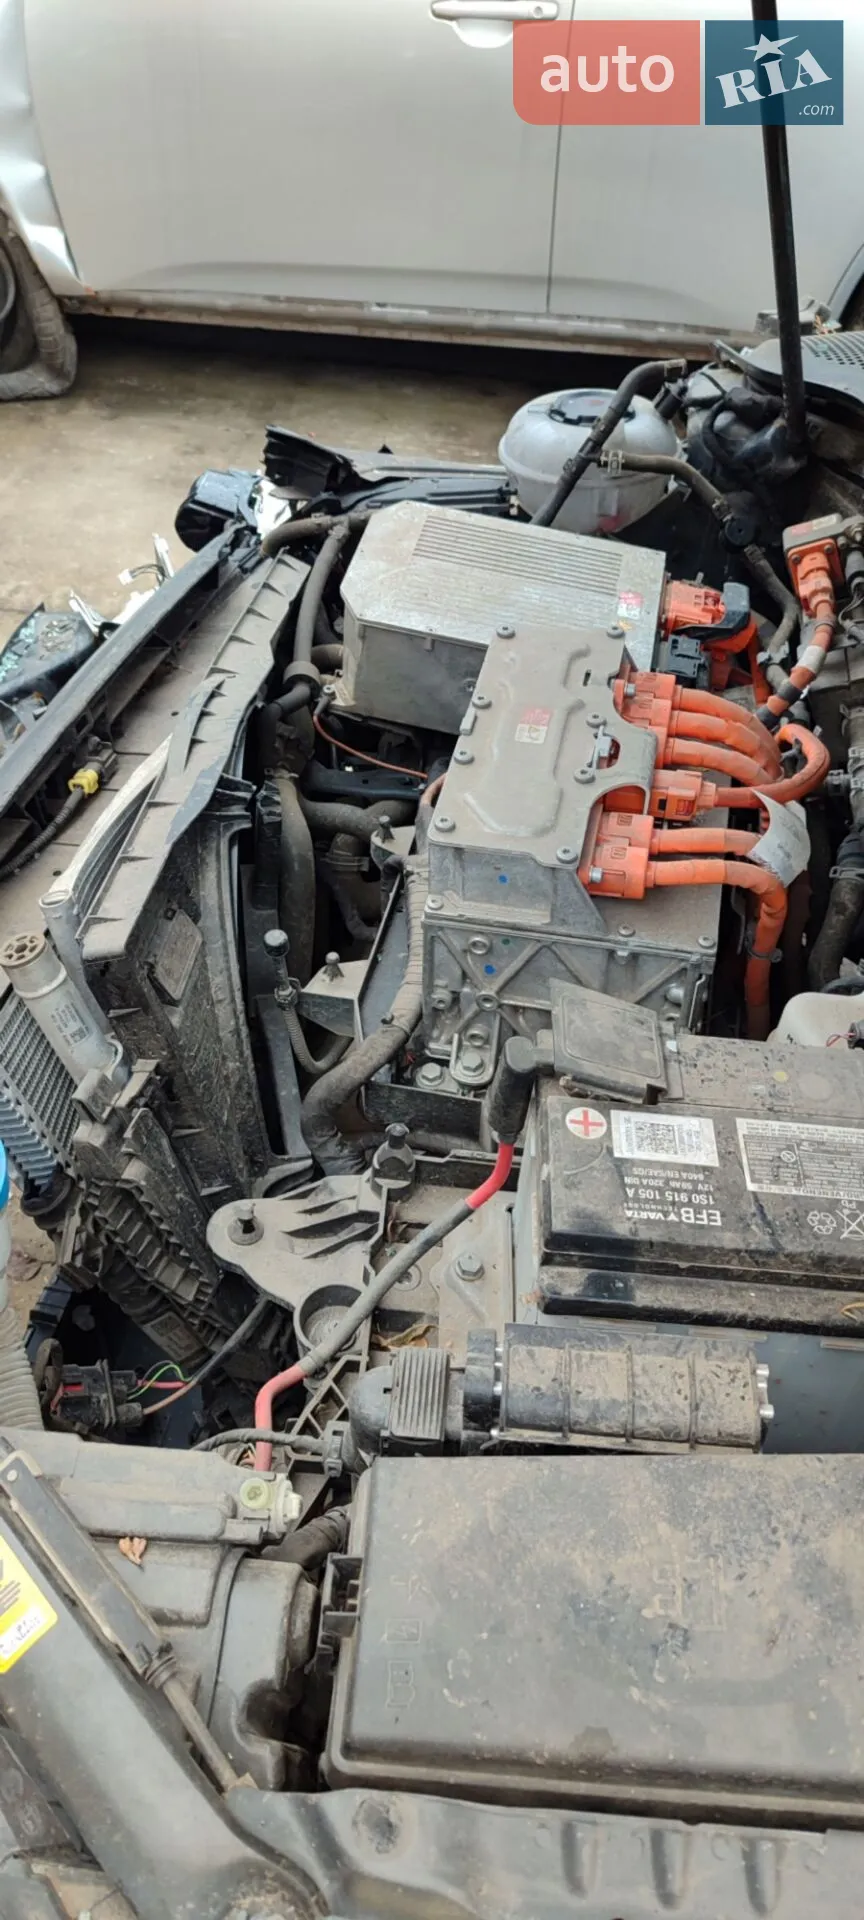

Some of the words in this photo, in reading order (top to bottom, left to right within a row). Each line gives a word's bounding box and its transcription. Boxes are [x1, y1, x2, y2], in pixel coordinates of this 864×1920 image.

[625, 1187, 635, 1198] A
[698, 1183, 714, 1192] 12V
[638, 1188, 660, 1200] 105
[665, 1191, 688, 1203] 915
[692, 1193, 715, 1205] 1S0
[841, 1200, 856, 1209] Pb
[624, 1210, 665, 1220] VARTA
[680, 1207, 722, 1226] EFB
